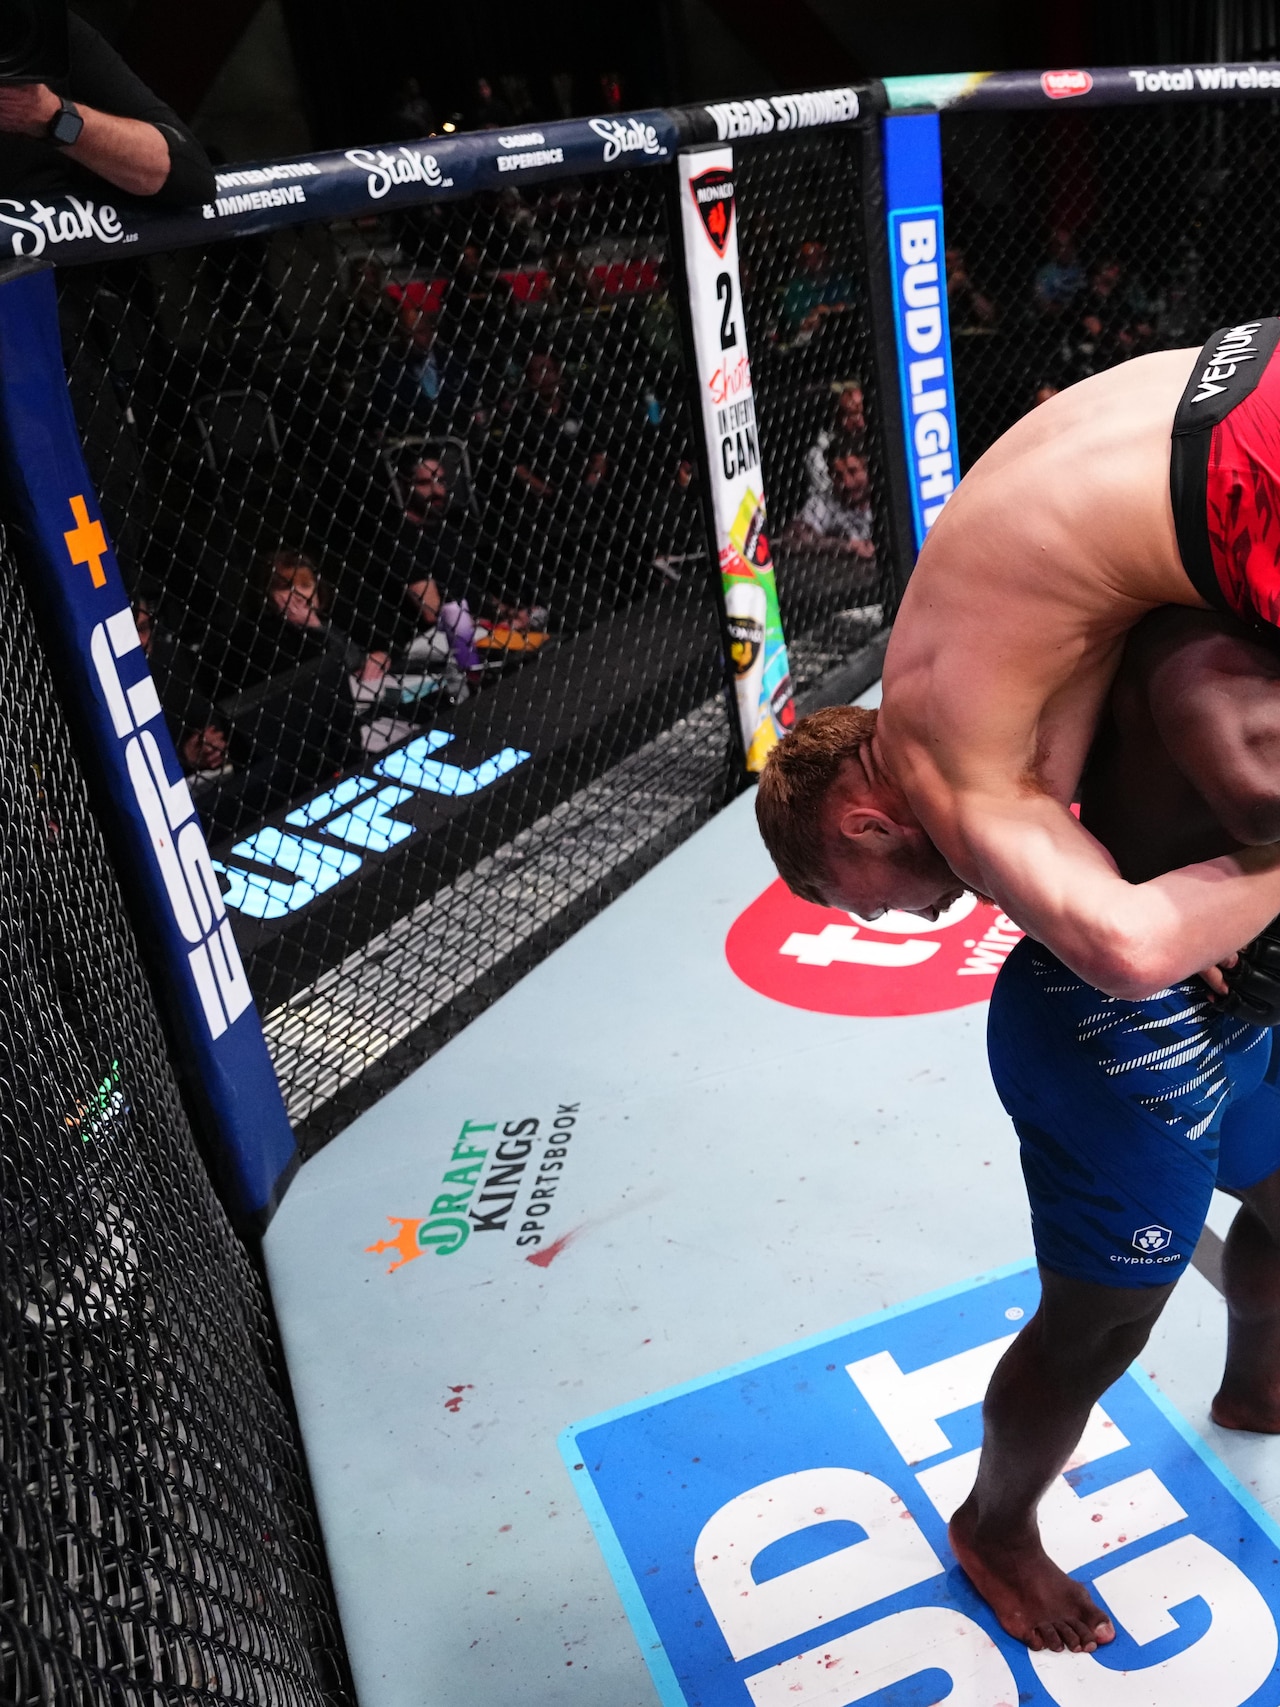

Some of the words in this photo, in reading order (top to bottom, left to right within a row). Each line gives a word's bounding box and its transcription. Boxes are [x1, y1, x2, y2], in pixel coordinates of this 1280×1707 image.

[1128, 69, 1194, 92] Total
[588, 118, 659, 162] Stake
[704, 98, 775, 141] VEGAS
[770, 87, 860, 131] STRONGER
[344, 146, 442, 199] Stake
[496, 148, 564, 172] EXPERIENCE
[0, 194, 125, 257] Stake
[202, 203, 216, 219] &
[215, 185, 307, 216] IMMERSIVE
[716, 272, 737, 351] 2
[901, 219, 941, 354] BUD
[1191, 322, 1263, 403] VENUM
[722, 427, 759, 480] CAN
[212, 729, 531, 919] UFC
[418, 1118, 498, 1256] DRAFT
[468, 1117, 540, 1232] KINGS
[516, 1102, 581, 1246] SPORTSBOOK
[1110, 1253, 1181, 1265] crypto.com
